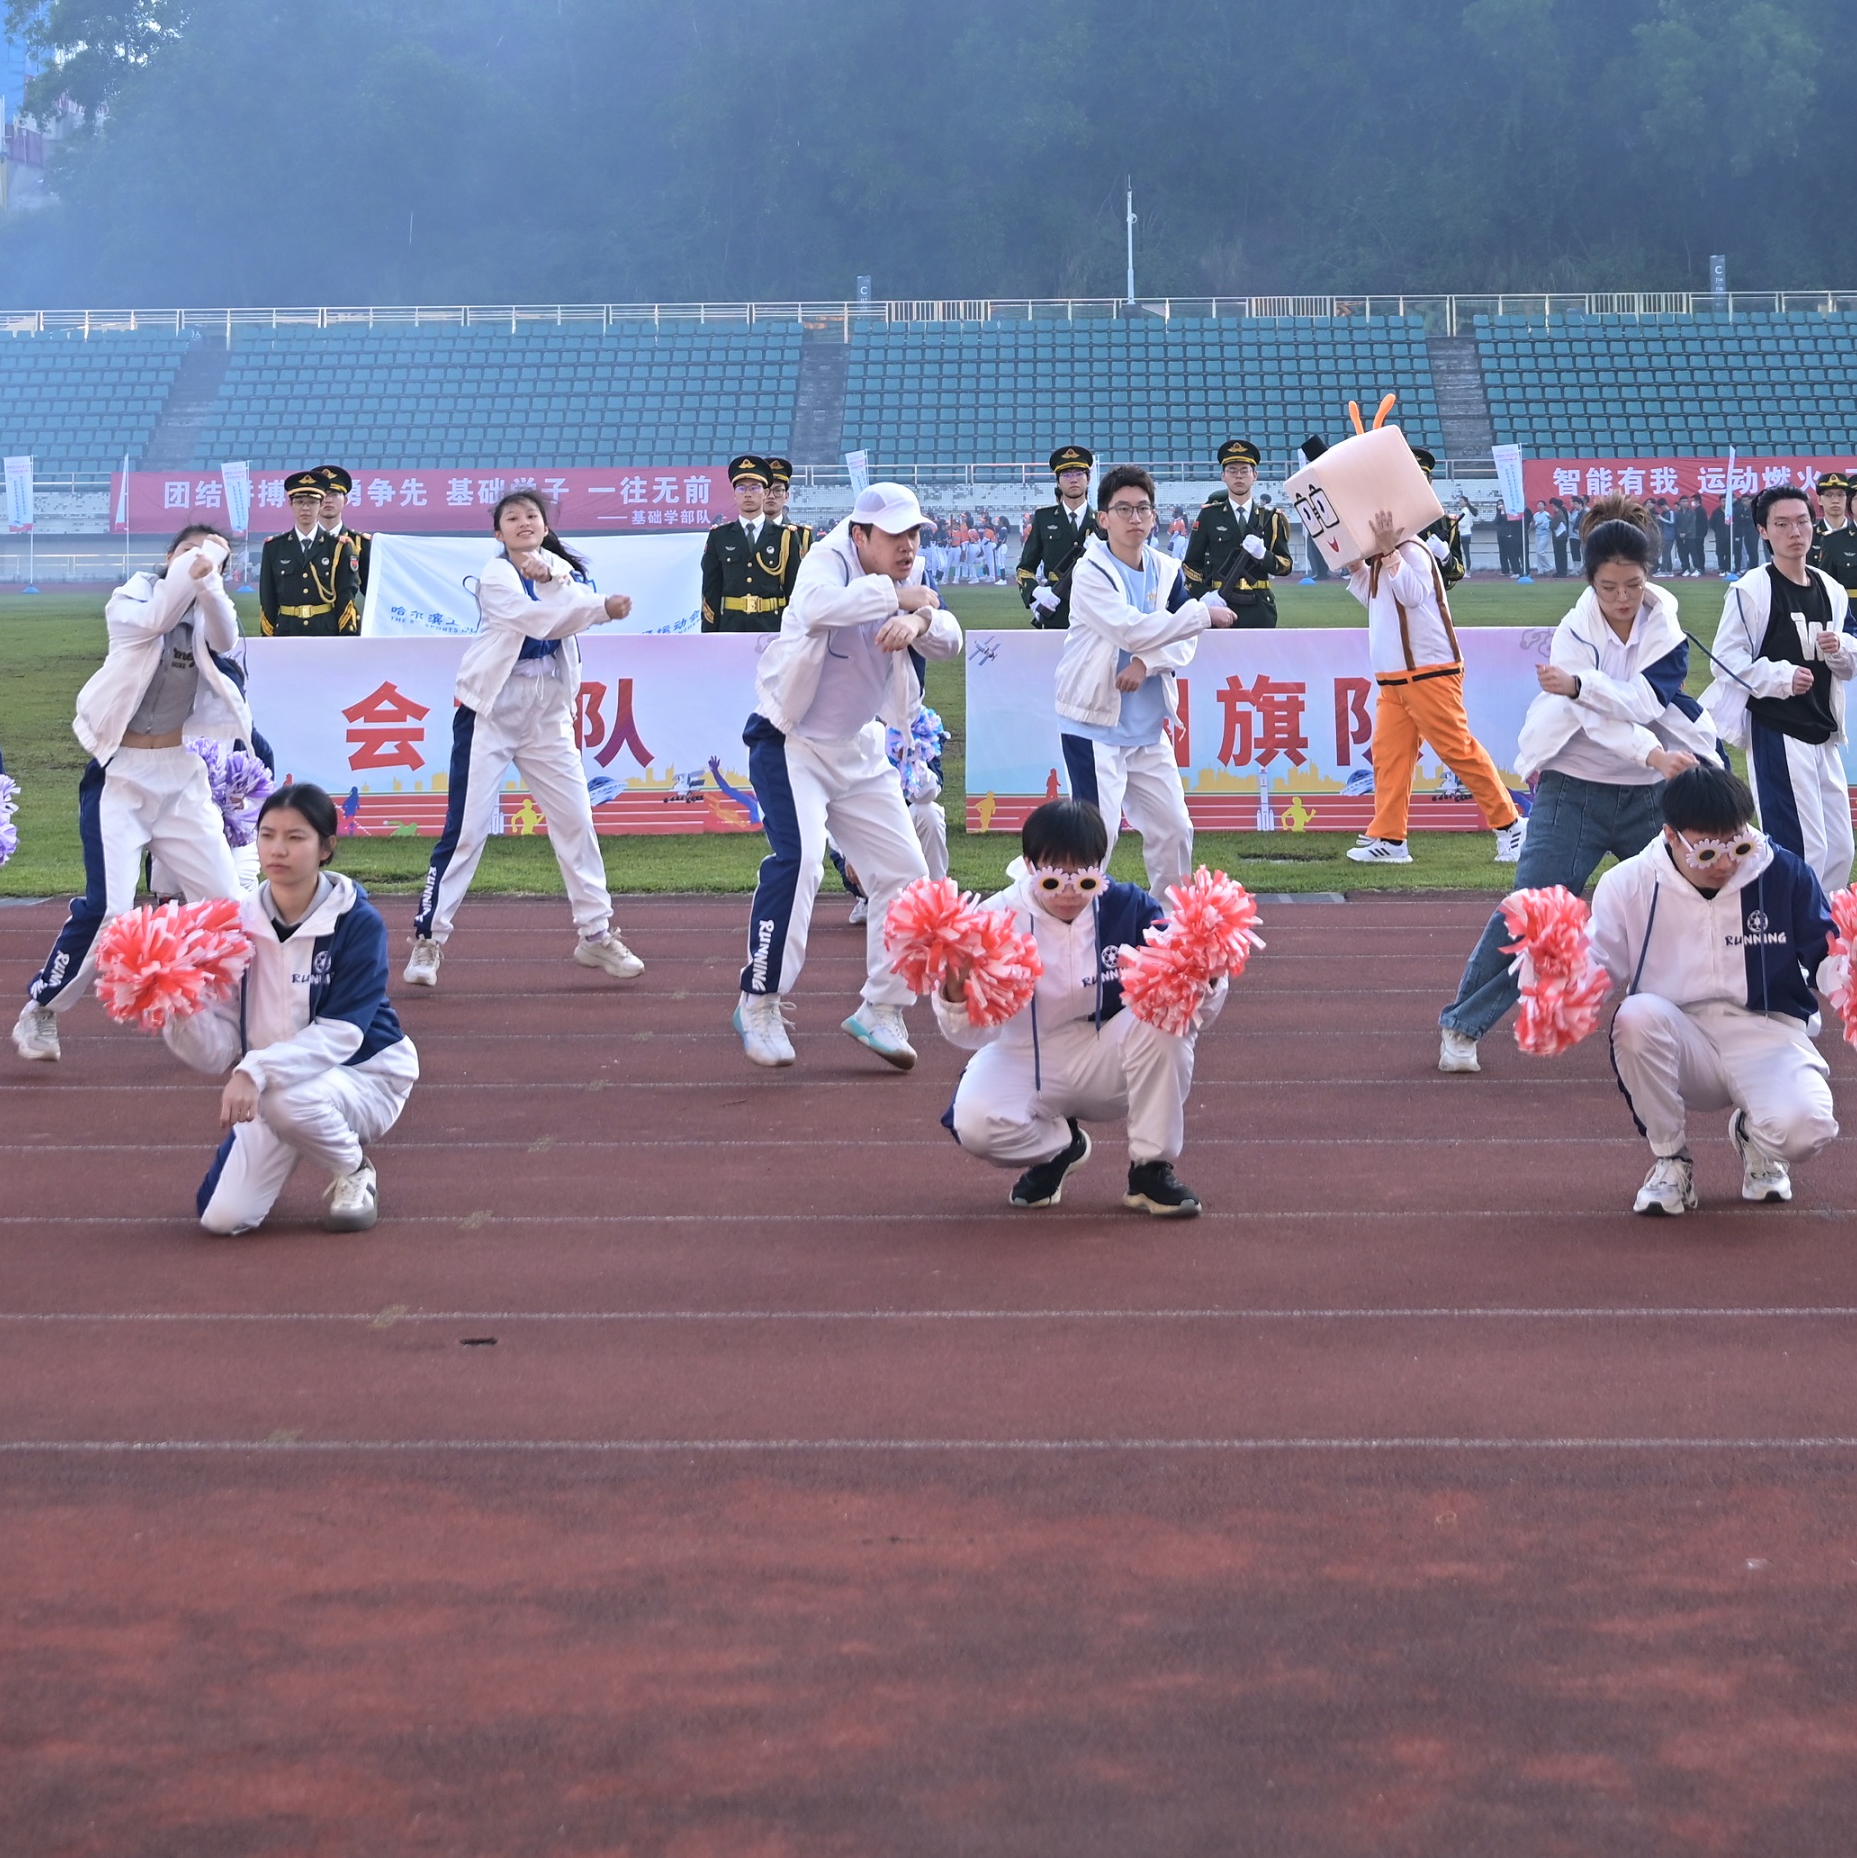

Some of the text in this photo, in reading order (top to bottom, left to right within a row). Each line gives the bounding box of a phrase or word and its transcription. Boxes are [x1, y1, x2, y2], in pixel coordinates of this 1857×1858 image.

[164, 480, 286, 509] 团结搏
[588, 475, 711, 504] 一往无前
[1553, 466, 1679, 496] 智能有我
[342, 678, 655, 771] 会队
[751, 919, 775, 992] RUNNING
[1725, 931, 1787, 946] RUNNING
